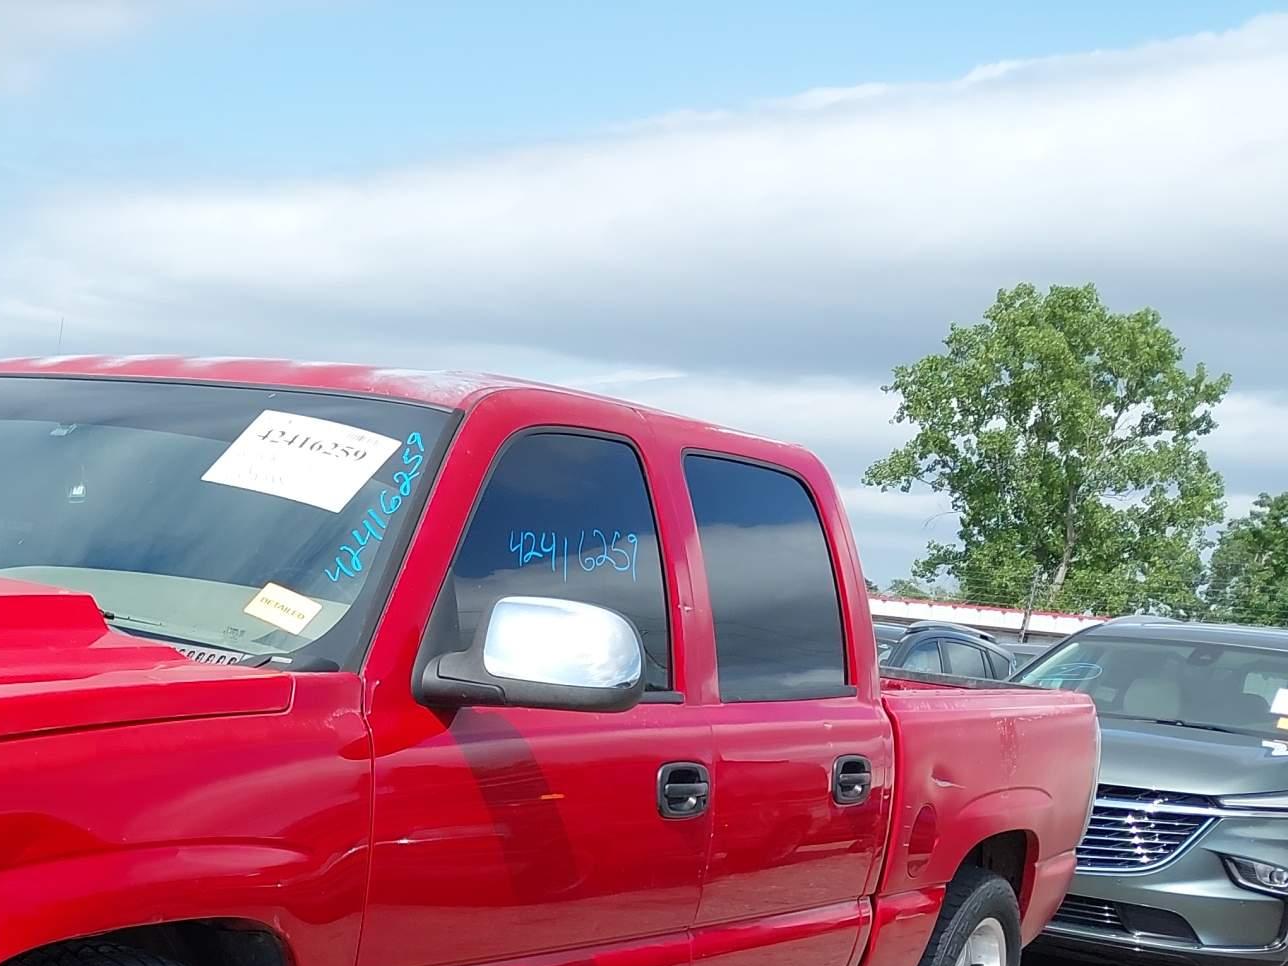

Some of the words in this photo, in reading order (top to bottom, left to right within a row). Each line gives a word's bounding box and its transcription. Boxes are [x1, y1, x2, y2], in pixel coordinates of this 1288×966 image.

[255, 427, 368, 463] 42416259
[323, 431, 425, 583] 42416259
[509, 529, 639, 583] 42416259
